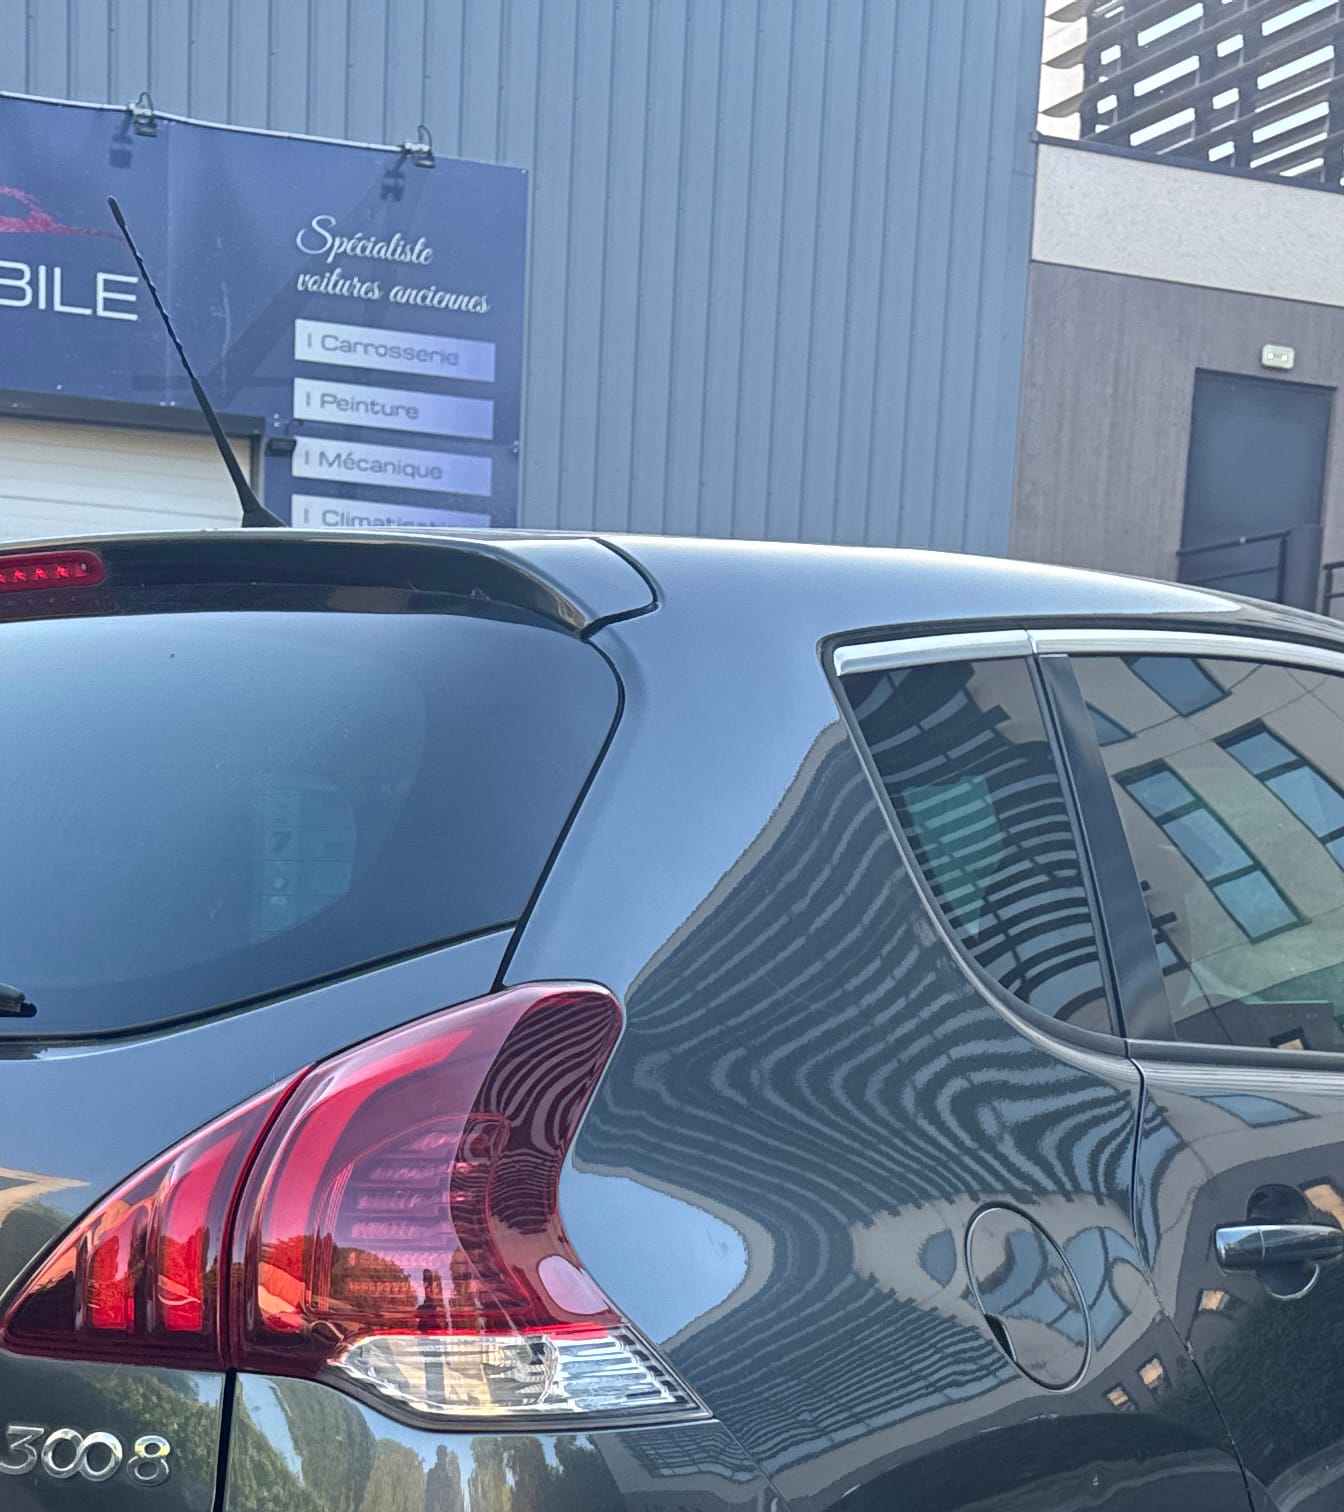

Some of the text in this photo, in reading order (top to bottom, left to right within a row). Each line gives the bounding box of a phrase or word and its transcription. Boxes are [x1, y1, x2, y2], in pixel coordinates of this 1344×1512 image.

[296, 215, 433, 264] Spécialiste
[297, 268, 492, 314] voitures anciennes
[321, 334, 459, 367] Carrosserie
[320, 393, 419, 419] Peinture
[318, 450, 443, 480] Mécanique
